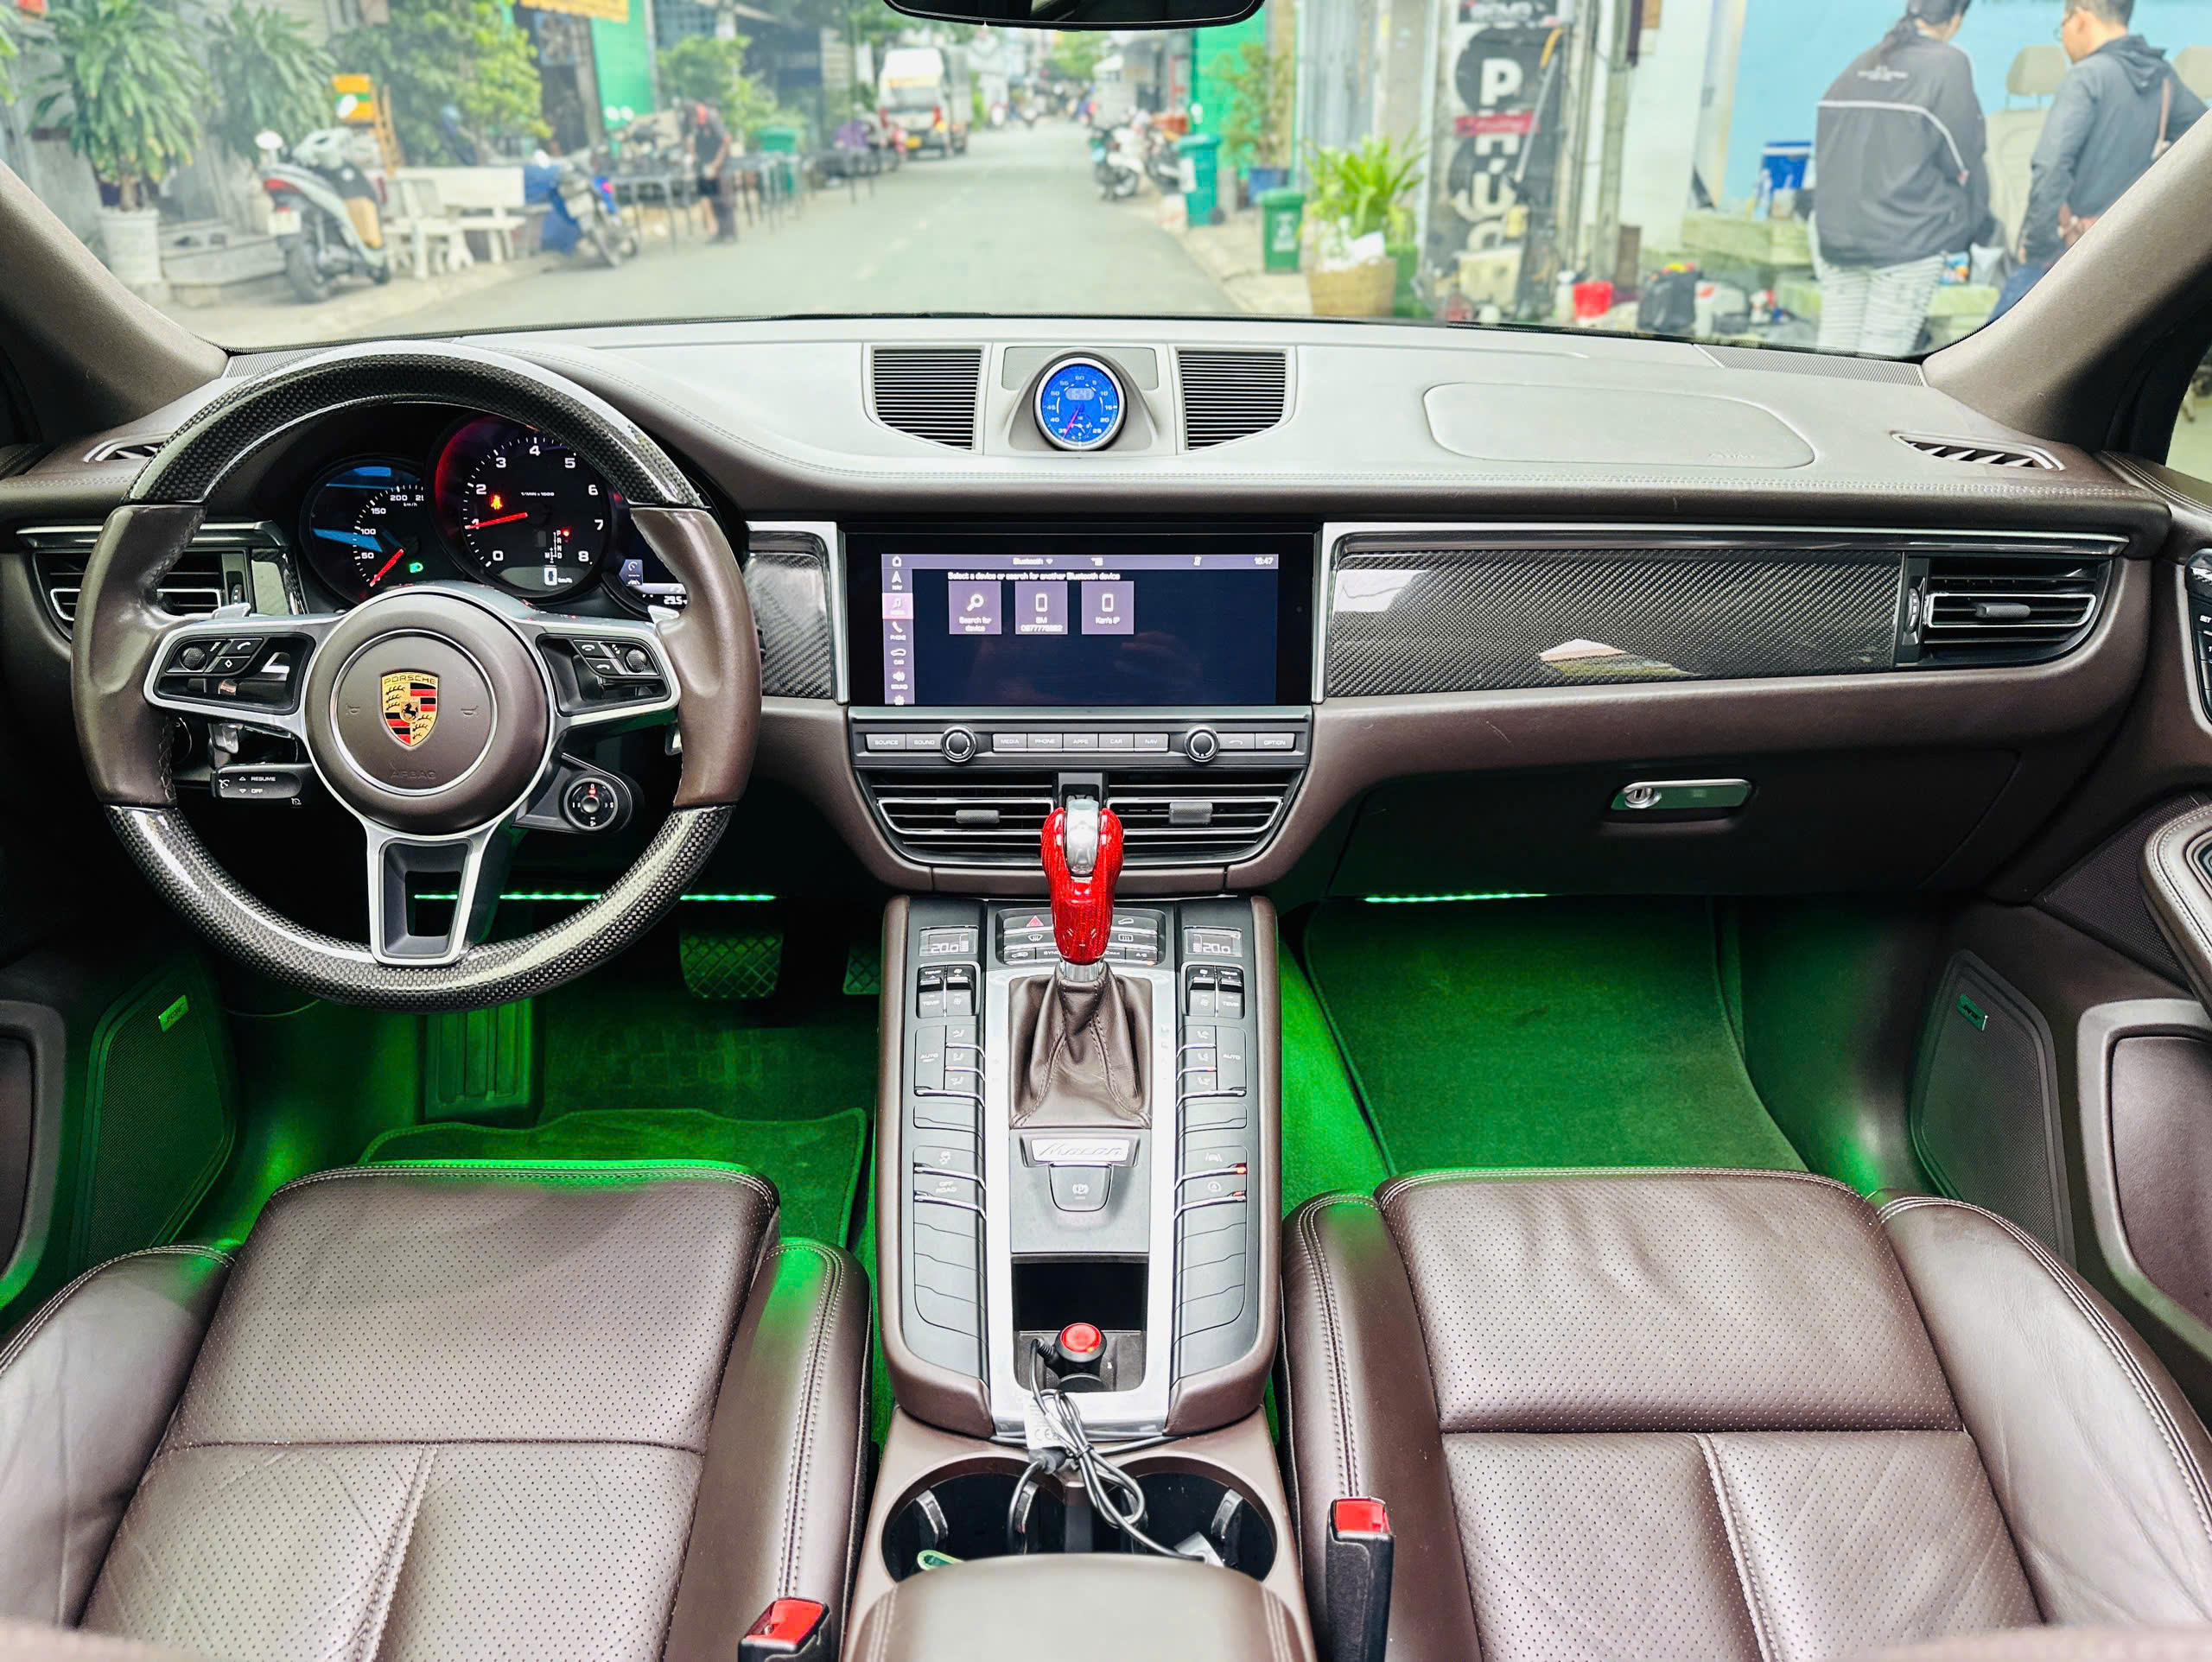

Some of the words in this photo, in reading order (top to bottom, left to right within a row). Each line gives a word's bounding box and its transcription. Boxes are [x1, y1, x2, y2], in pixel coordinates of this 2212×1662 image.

[529, 445, 541, 456] 4
[495, 457, 506, 468] 3
[564, 457, 575, 468] 5
[475, 484, 486, 495] 2
[588, 484, 599, 496] 6
[594, 519, 604, 530] 7
[493, 550, 504, 561] 0
[578, 550, 589, 561] 8
[543, 567, 557, 586] 0
[948, 572, 969, 580] Select
[976, 572, 996, 580] device
[1006, 572, 1028, 580] search
[1029, 572, 1039, 580] for
[1040, 572, 1066, 580] another
[1067, 572, 1098, 580] Bluetooth
[1099, 572, 1120, 580] device
[384, 675, 436, 685] PORSCHE
[1039, 1142, 1122, 1156] Macan
